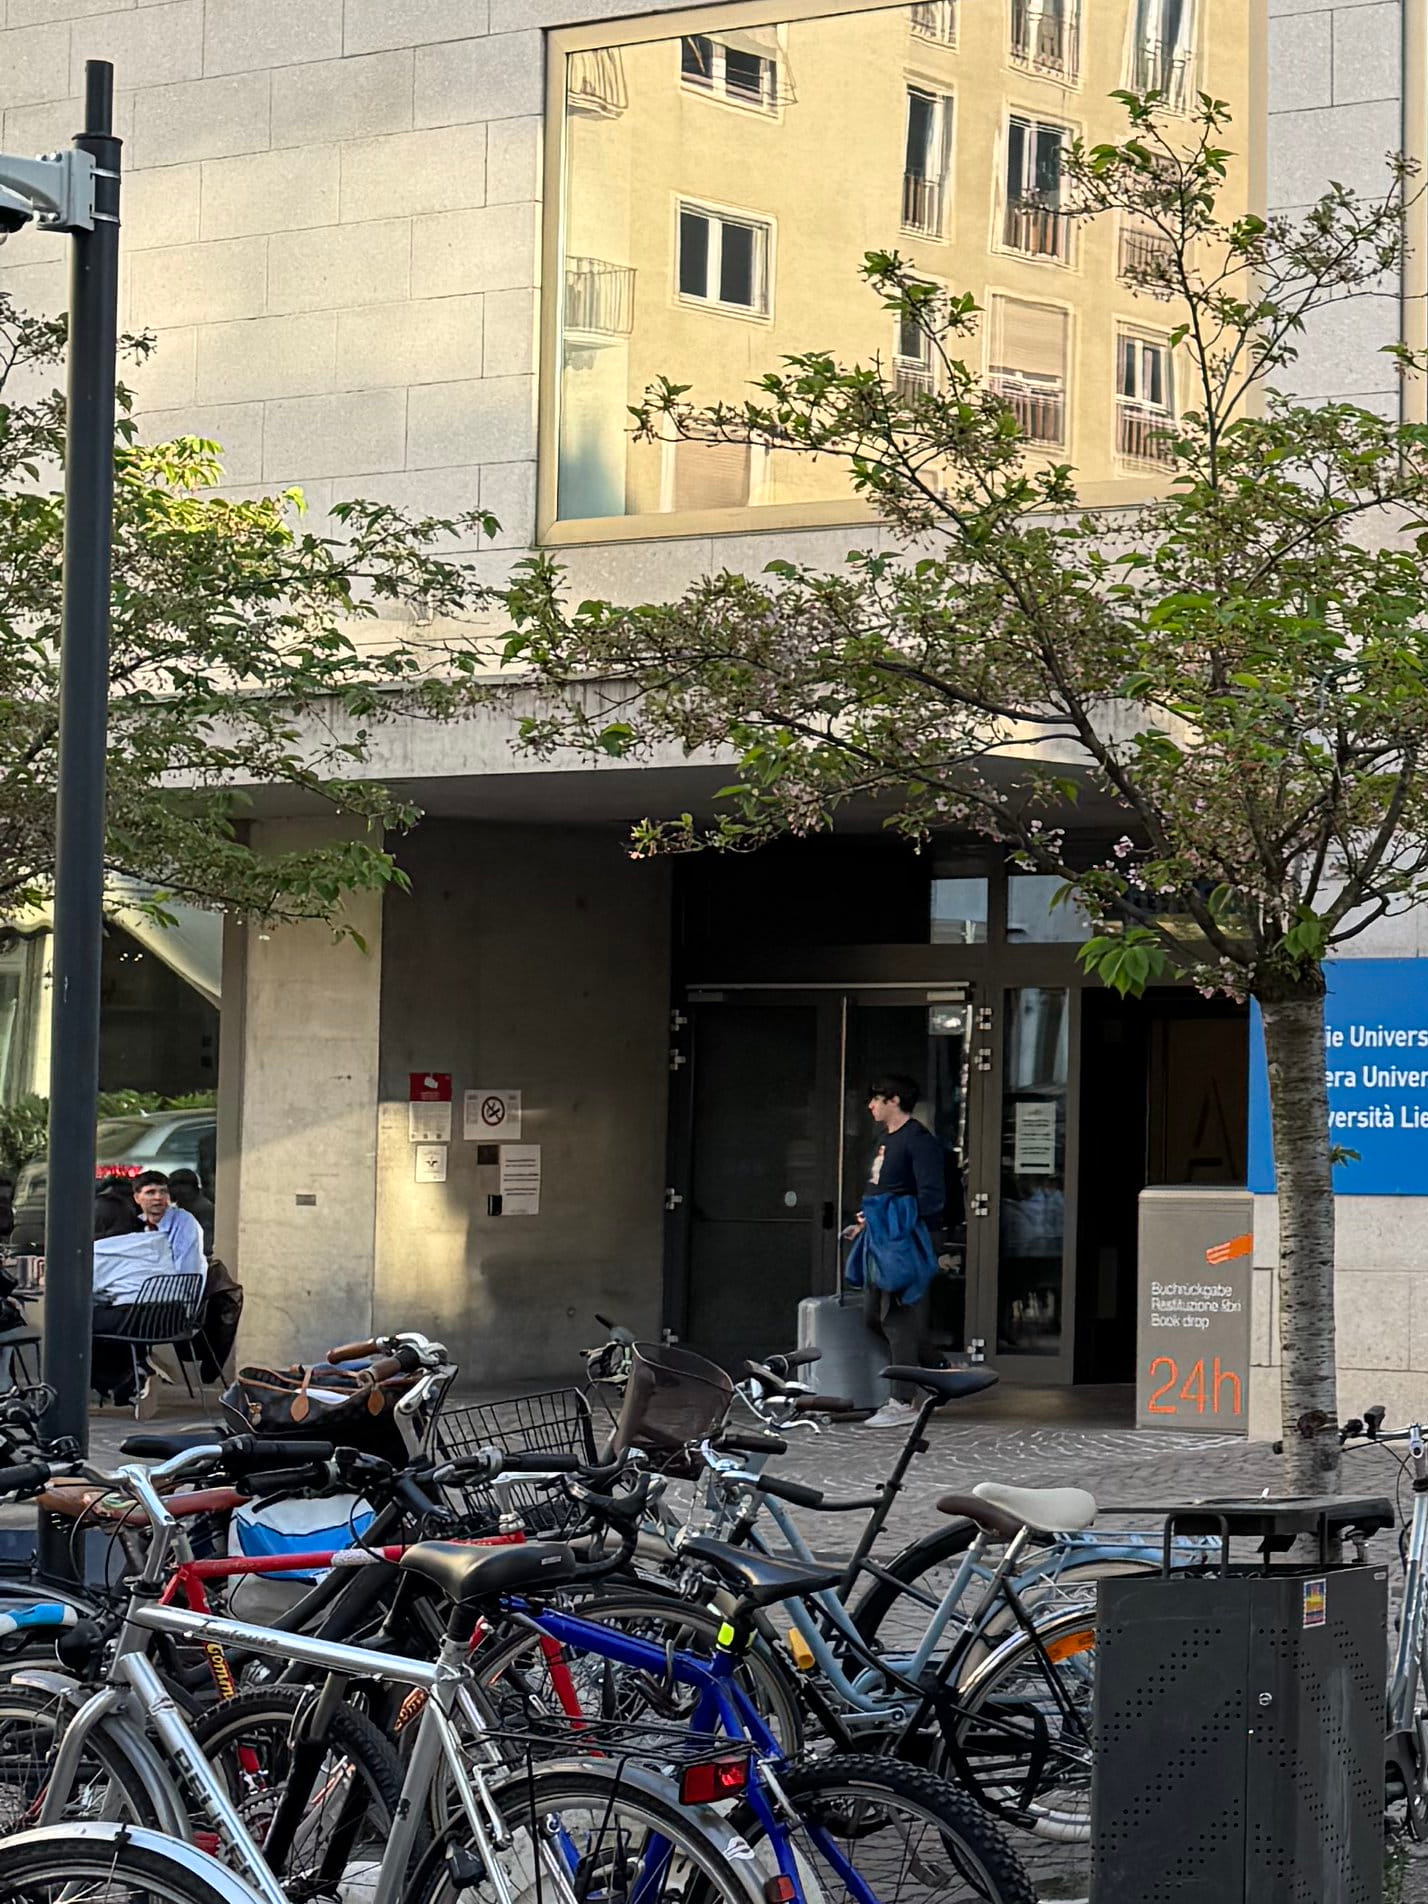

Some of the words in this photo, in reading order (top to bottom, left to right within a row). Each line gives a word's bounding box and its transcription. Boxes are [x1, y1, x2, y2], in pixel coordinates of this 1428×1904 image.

[1151, 1313, 1180, 1327] Book
[1183, 1314, 1210, 1330] drop
[1147, 1356, 1242, 1415] 24h
